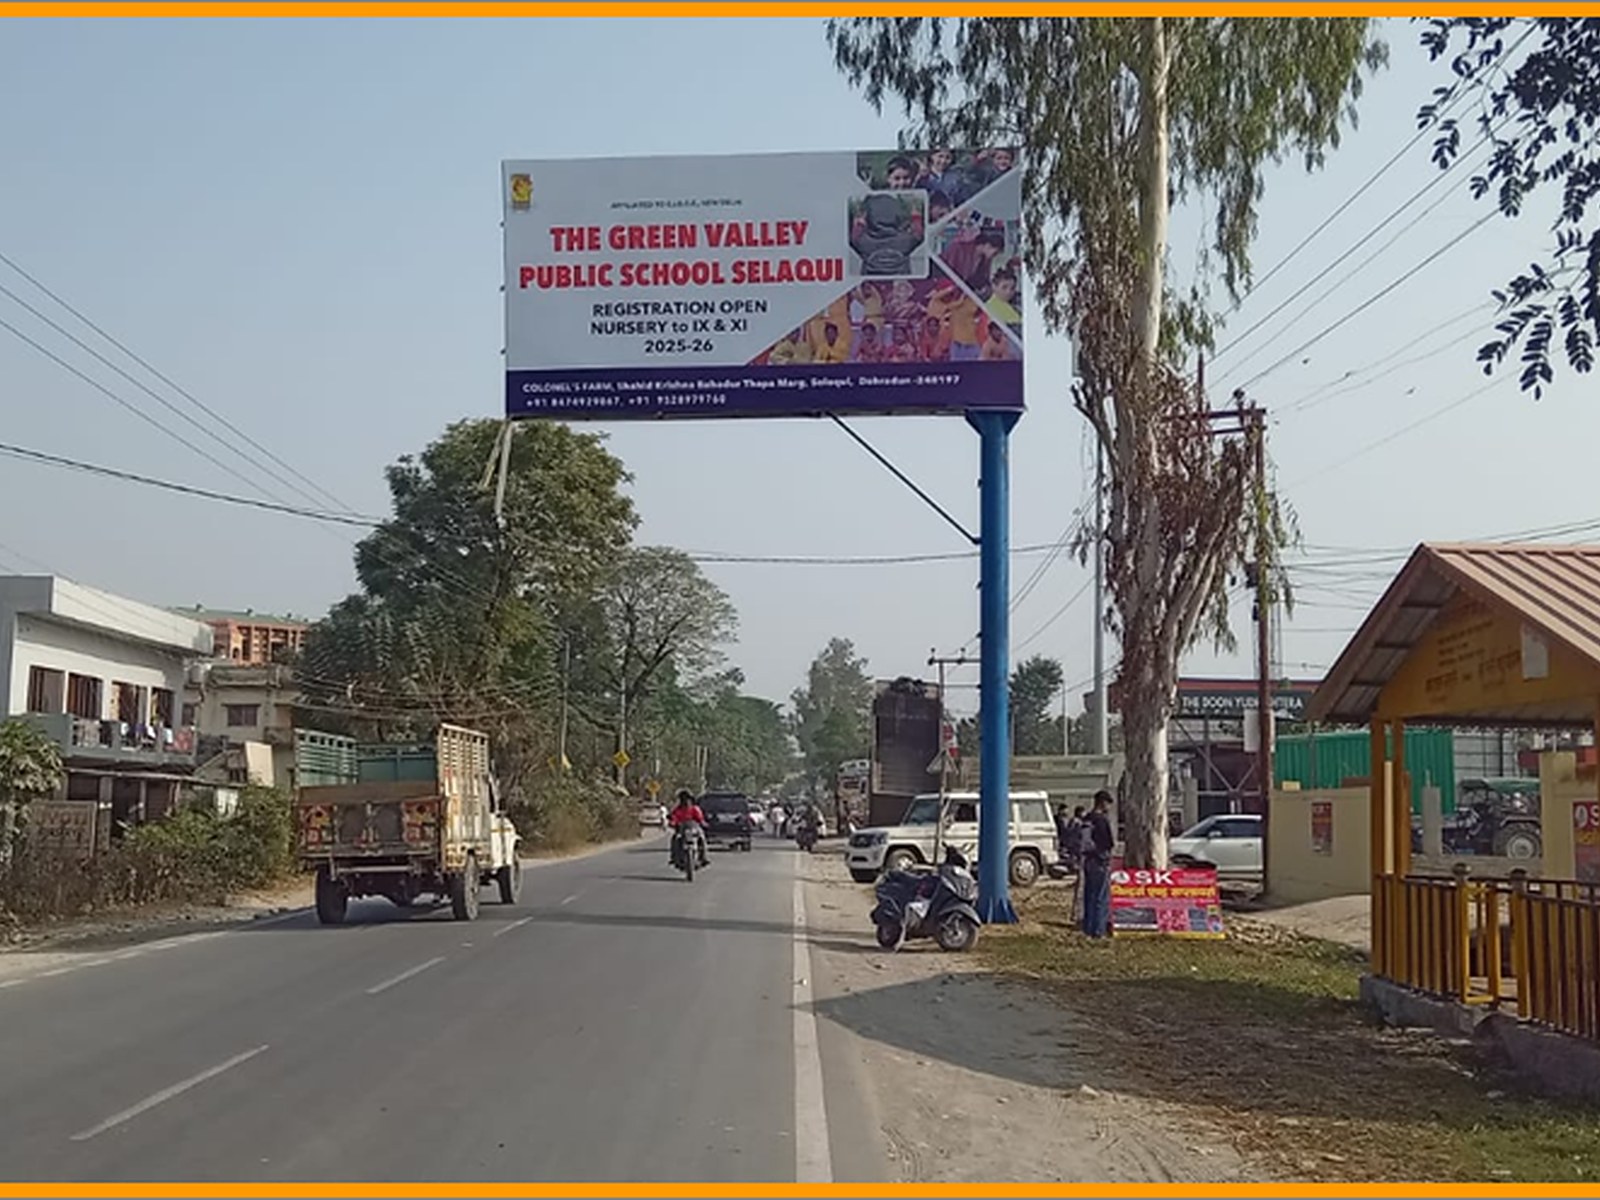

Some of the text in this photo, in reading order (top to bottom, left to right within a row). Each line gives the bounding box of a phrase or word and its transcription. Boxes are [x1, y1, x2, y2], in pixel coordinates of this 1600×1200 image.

[550, 221, 808, 251] THE GREEN VALLEY
[519, 258, 843, 289] PUBLIC SCHOOL SELAQUI
[593, 300, 767, 317] REGISTRATION OPEN
[591, 318, 747, 335] NURSERY to IX & XI
[645, 338, 713, 353] 2025-26
[522, 381, 580, 393] COLONEL'S
[617, 379, 653, 390] Shahid
[655, 378, 695, 390] Krishna
[697, 377, 741, 389] Bahadur
[743, 378, 775, 390] Thapa
[1182, 696, 1199, 707] THE
[1202, 696, 1232, 708] DOON
[1134, 870, 1174, 885] SK
